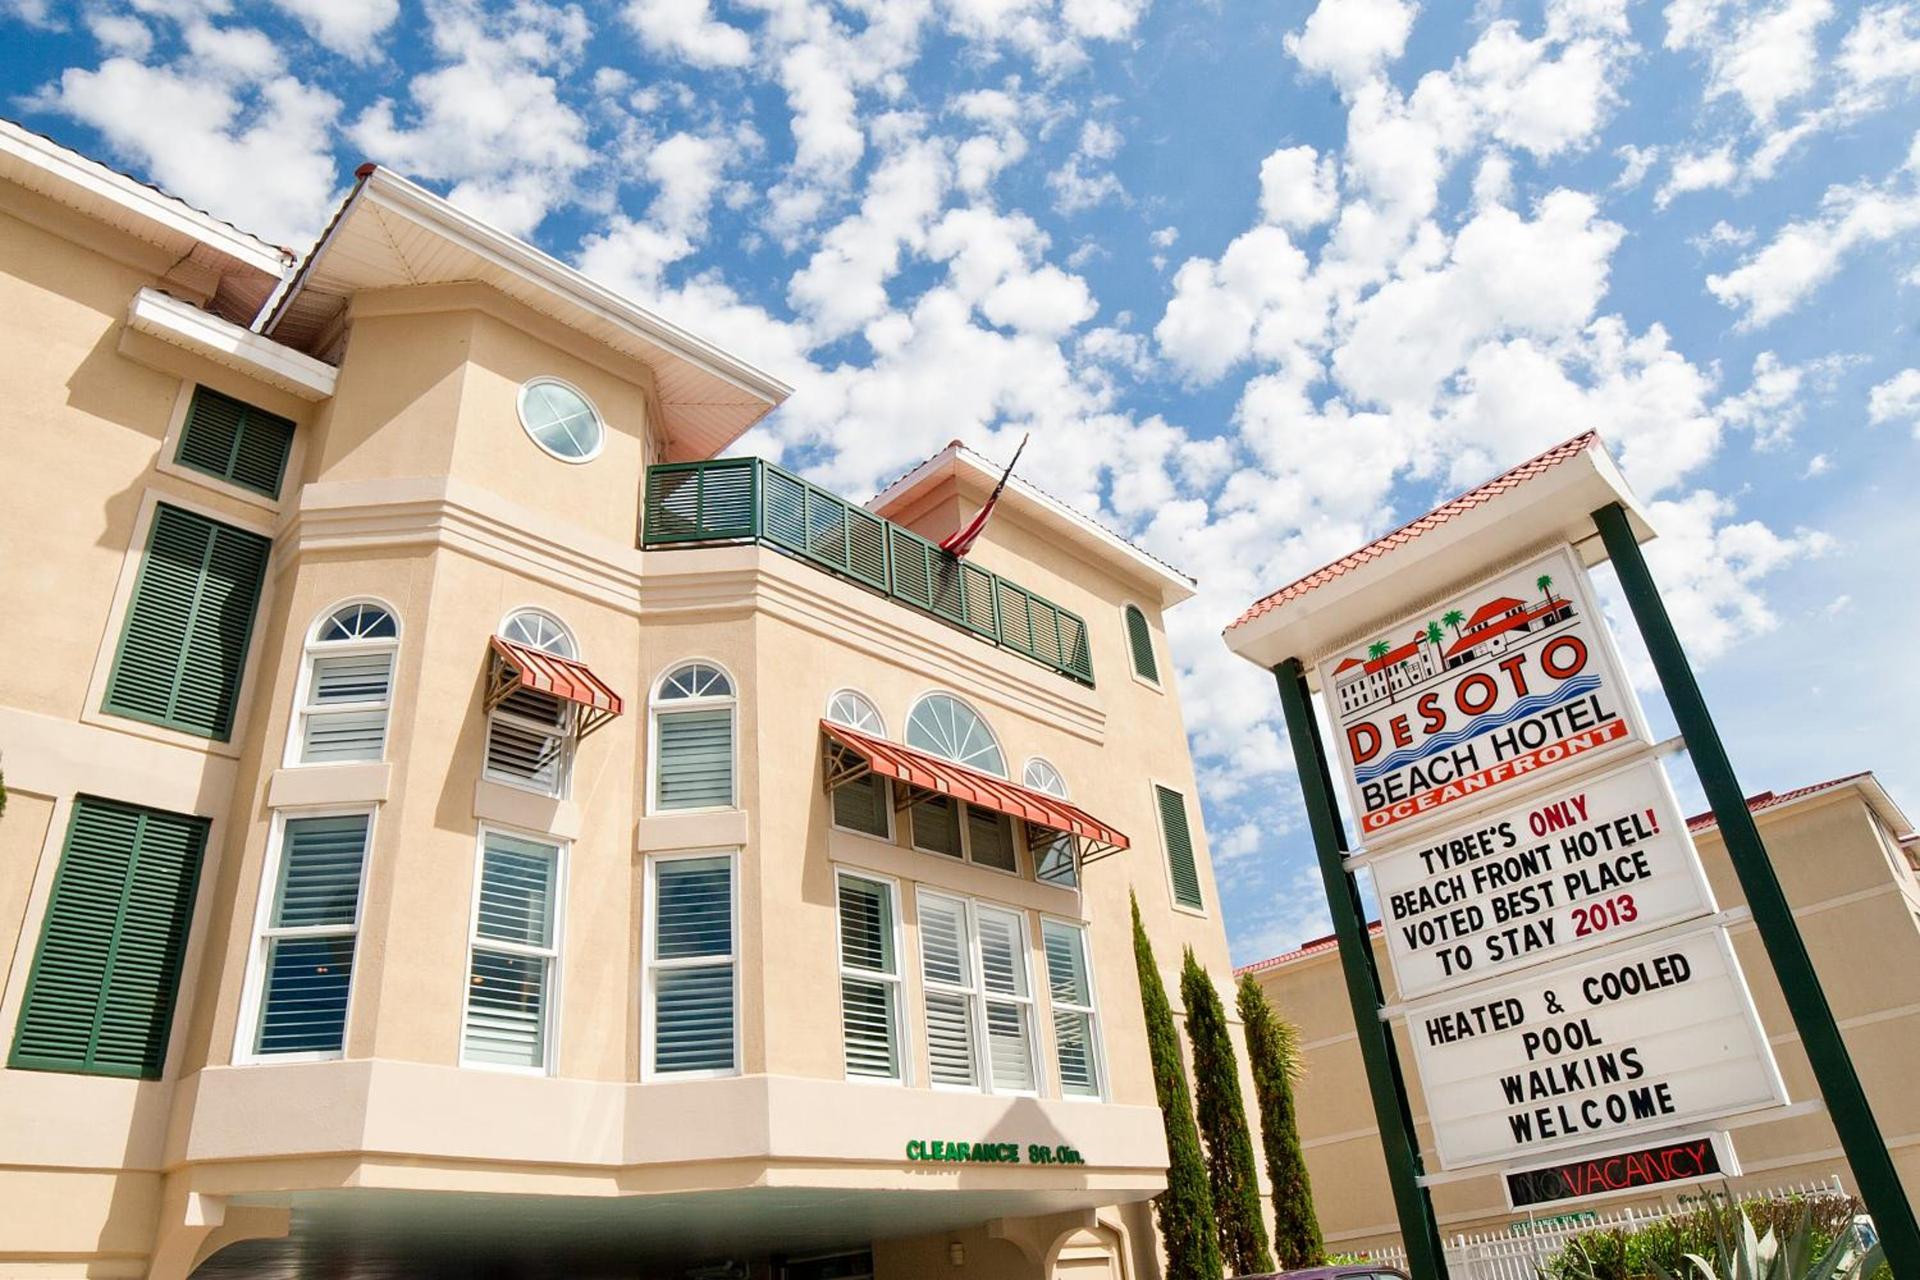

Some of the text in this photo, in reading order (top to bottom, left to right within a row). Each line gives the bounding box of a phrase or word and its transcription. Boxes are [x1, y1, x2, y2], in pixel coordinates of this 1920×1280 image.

[1361, 694, 1616, 812] BEACH HOTEL
[1368, 723, 1619, 828] OCEANFRONT
[1390, 808, 1660, 920] BEACH FRONT HOTEL!
[1420, 794, 1589, 875] TYBEE'S ONLY
[1403, 850, 1651, 950] VOTED BEST PLACE
[1436, 894, 1639, 976] TO STAY 2013
[1425, 952, 1691, 1046] HEATED & COOLED
[1522, 1018, 1602, 1061] POOL
[1500, 1047, 1644, 1105] WALKINS
[1508, 1082, 1676, 1144] WELCOME
[906, 1140, 1020, 1163] CLEARANCE
[1562, 1143, 1705, 1197] VACANCY
